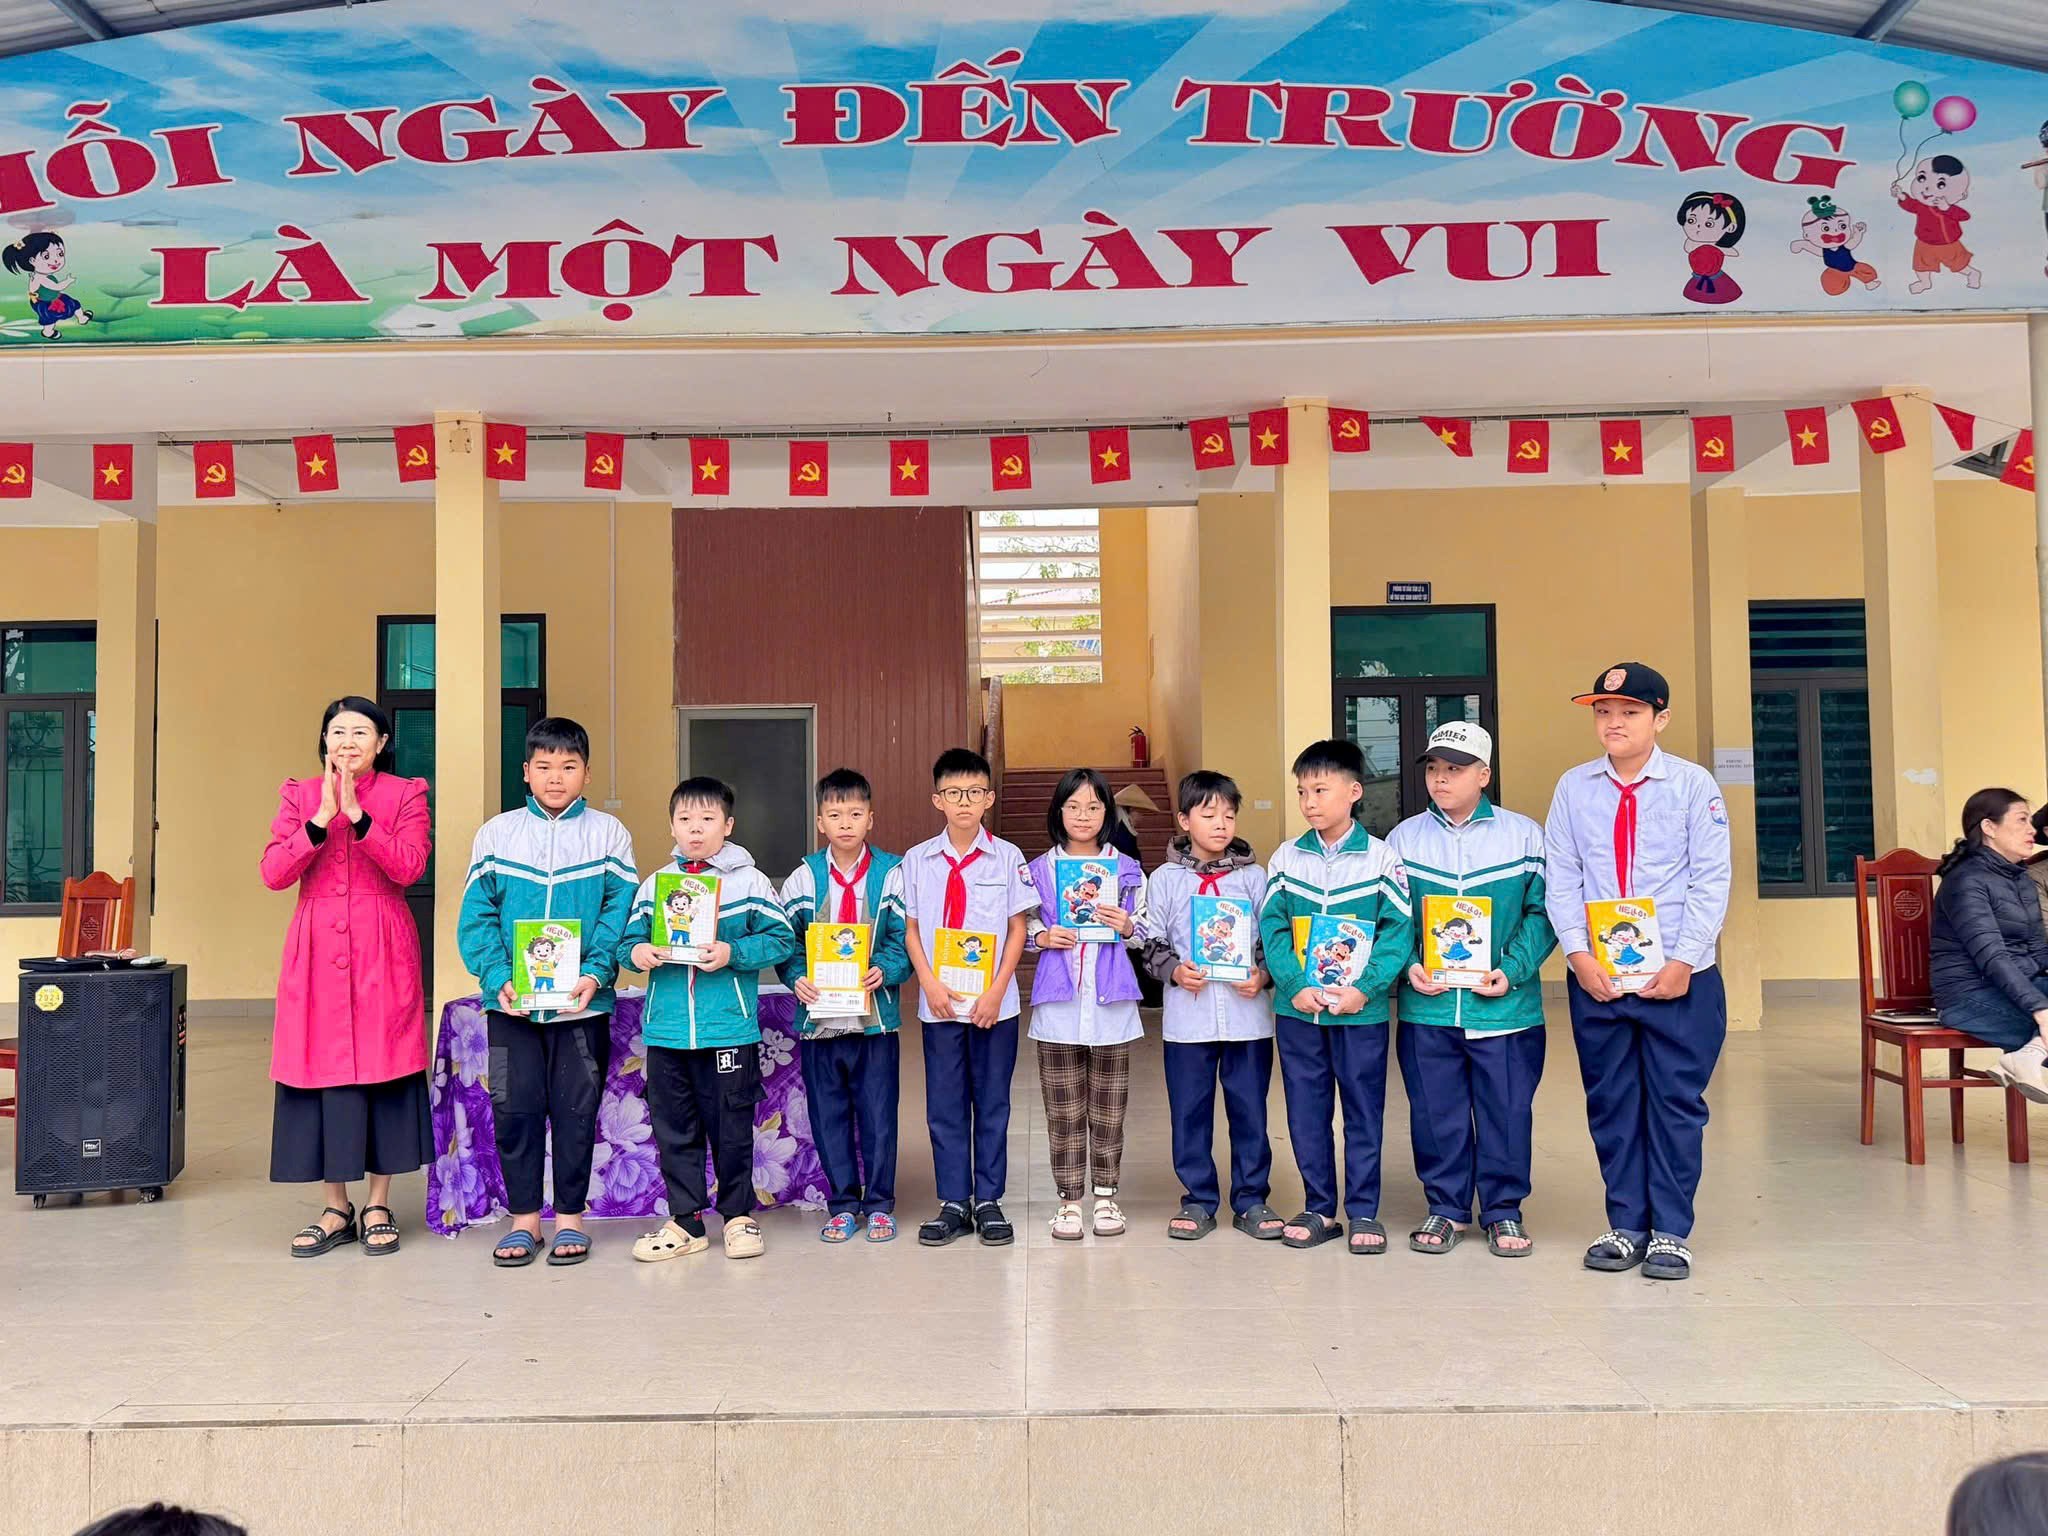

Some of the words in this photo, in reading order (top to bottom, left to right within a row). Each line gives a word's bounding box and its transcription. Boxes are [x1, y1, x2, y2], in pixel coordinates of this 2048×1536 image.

[283, 77, 725, 177] NGÀY
[782, 50, 1131, 147] ĐẾN
[1173, 76, 1857, 190] TRƯỜNG
[149, 223, 372, 309] LÀ
[417, 217, 780, 321] MỘT
[829, 209, 1273, 298] NGÀY
[1325, 219, 1612, 287] VUI
